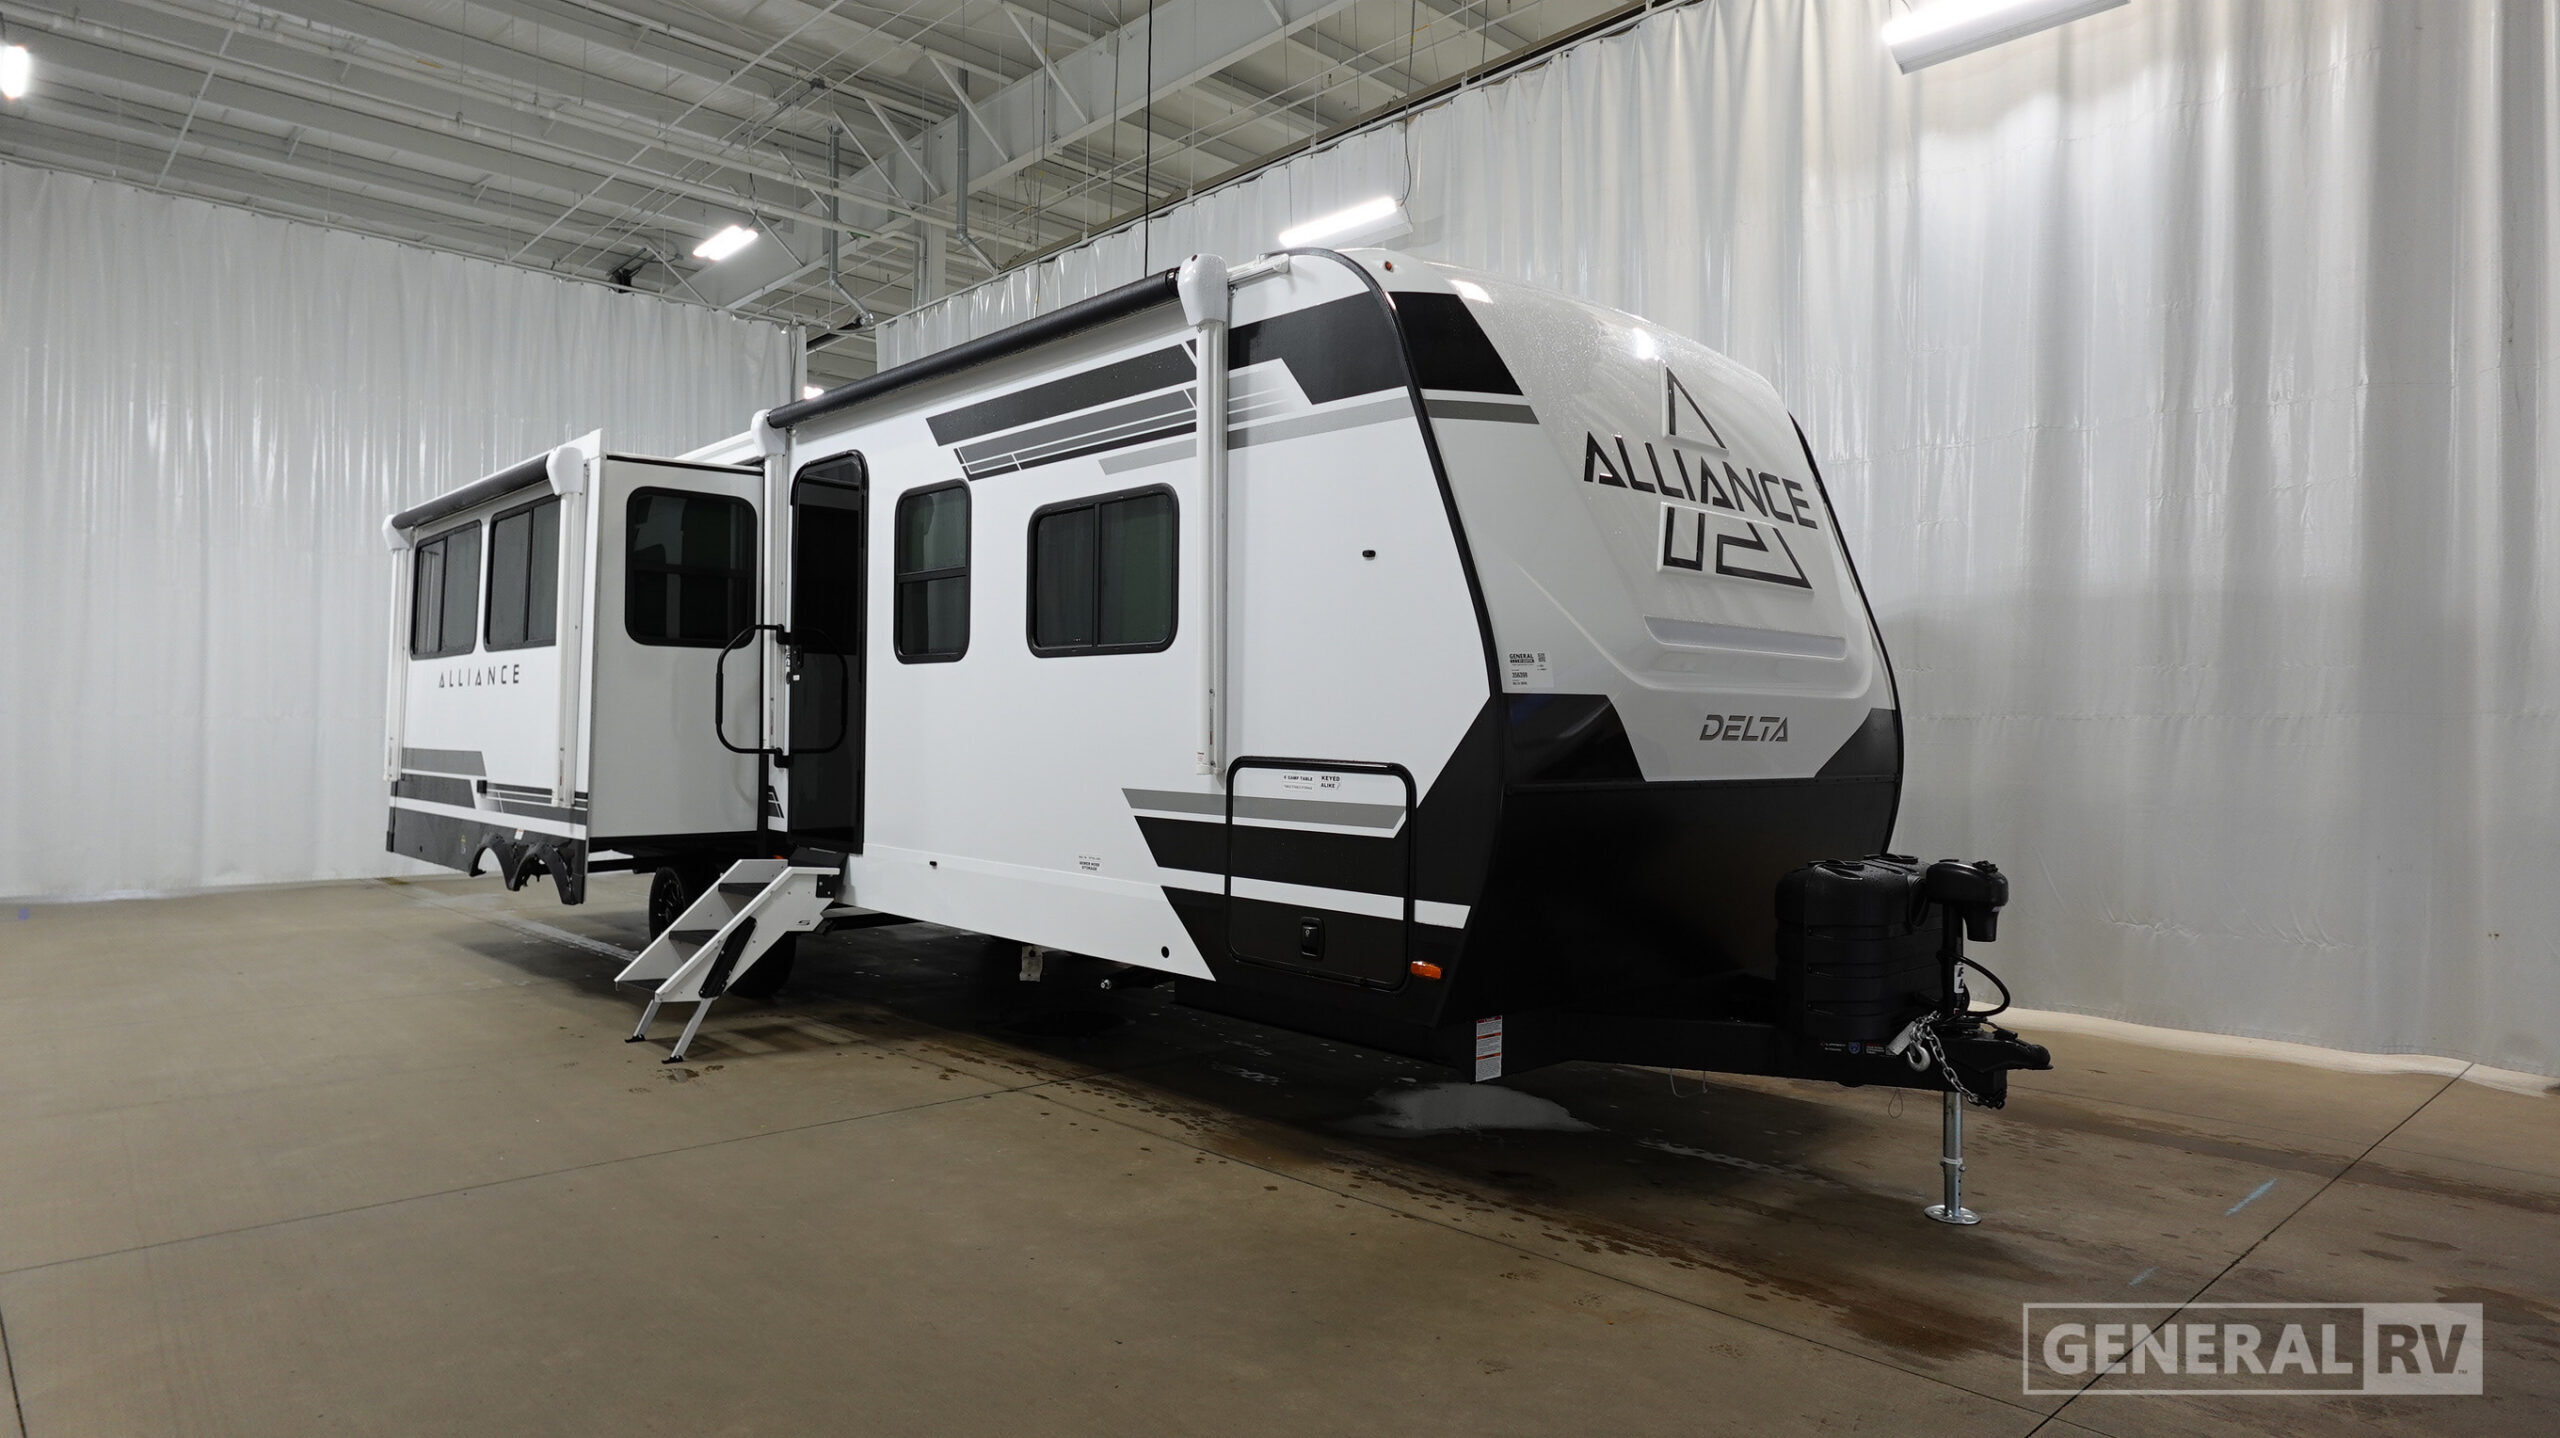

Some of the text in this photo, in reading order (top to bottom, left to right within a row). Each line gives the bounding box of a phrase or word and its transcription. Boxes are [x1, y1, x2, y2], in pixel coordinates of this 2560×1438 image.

[1584, 431, 1818, 530] ALLIANCE
[438, 664, 519, 688] ALLIANCE
[1699, 714, 1788, 742] DELTA
